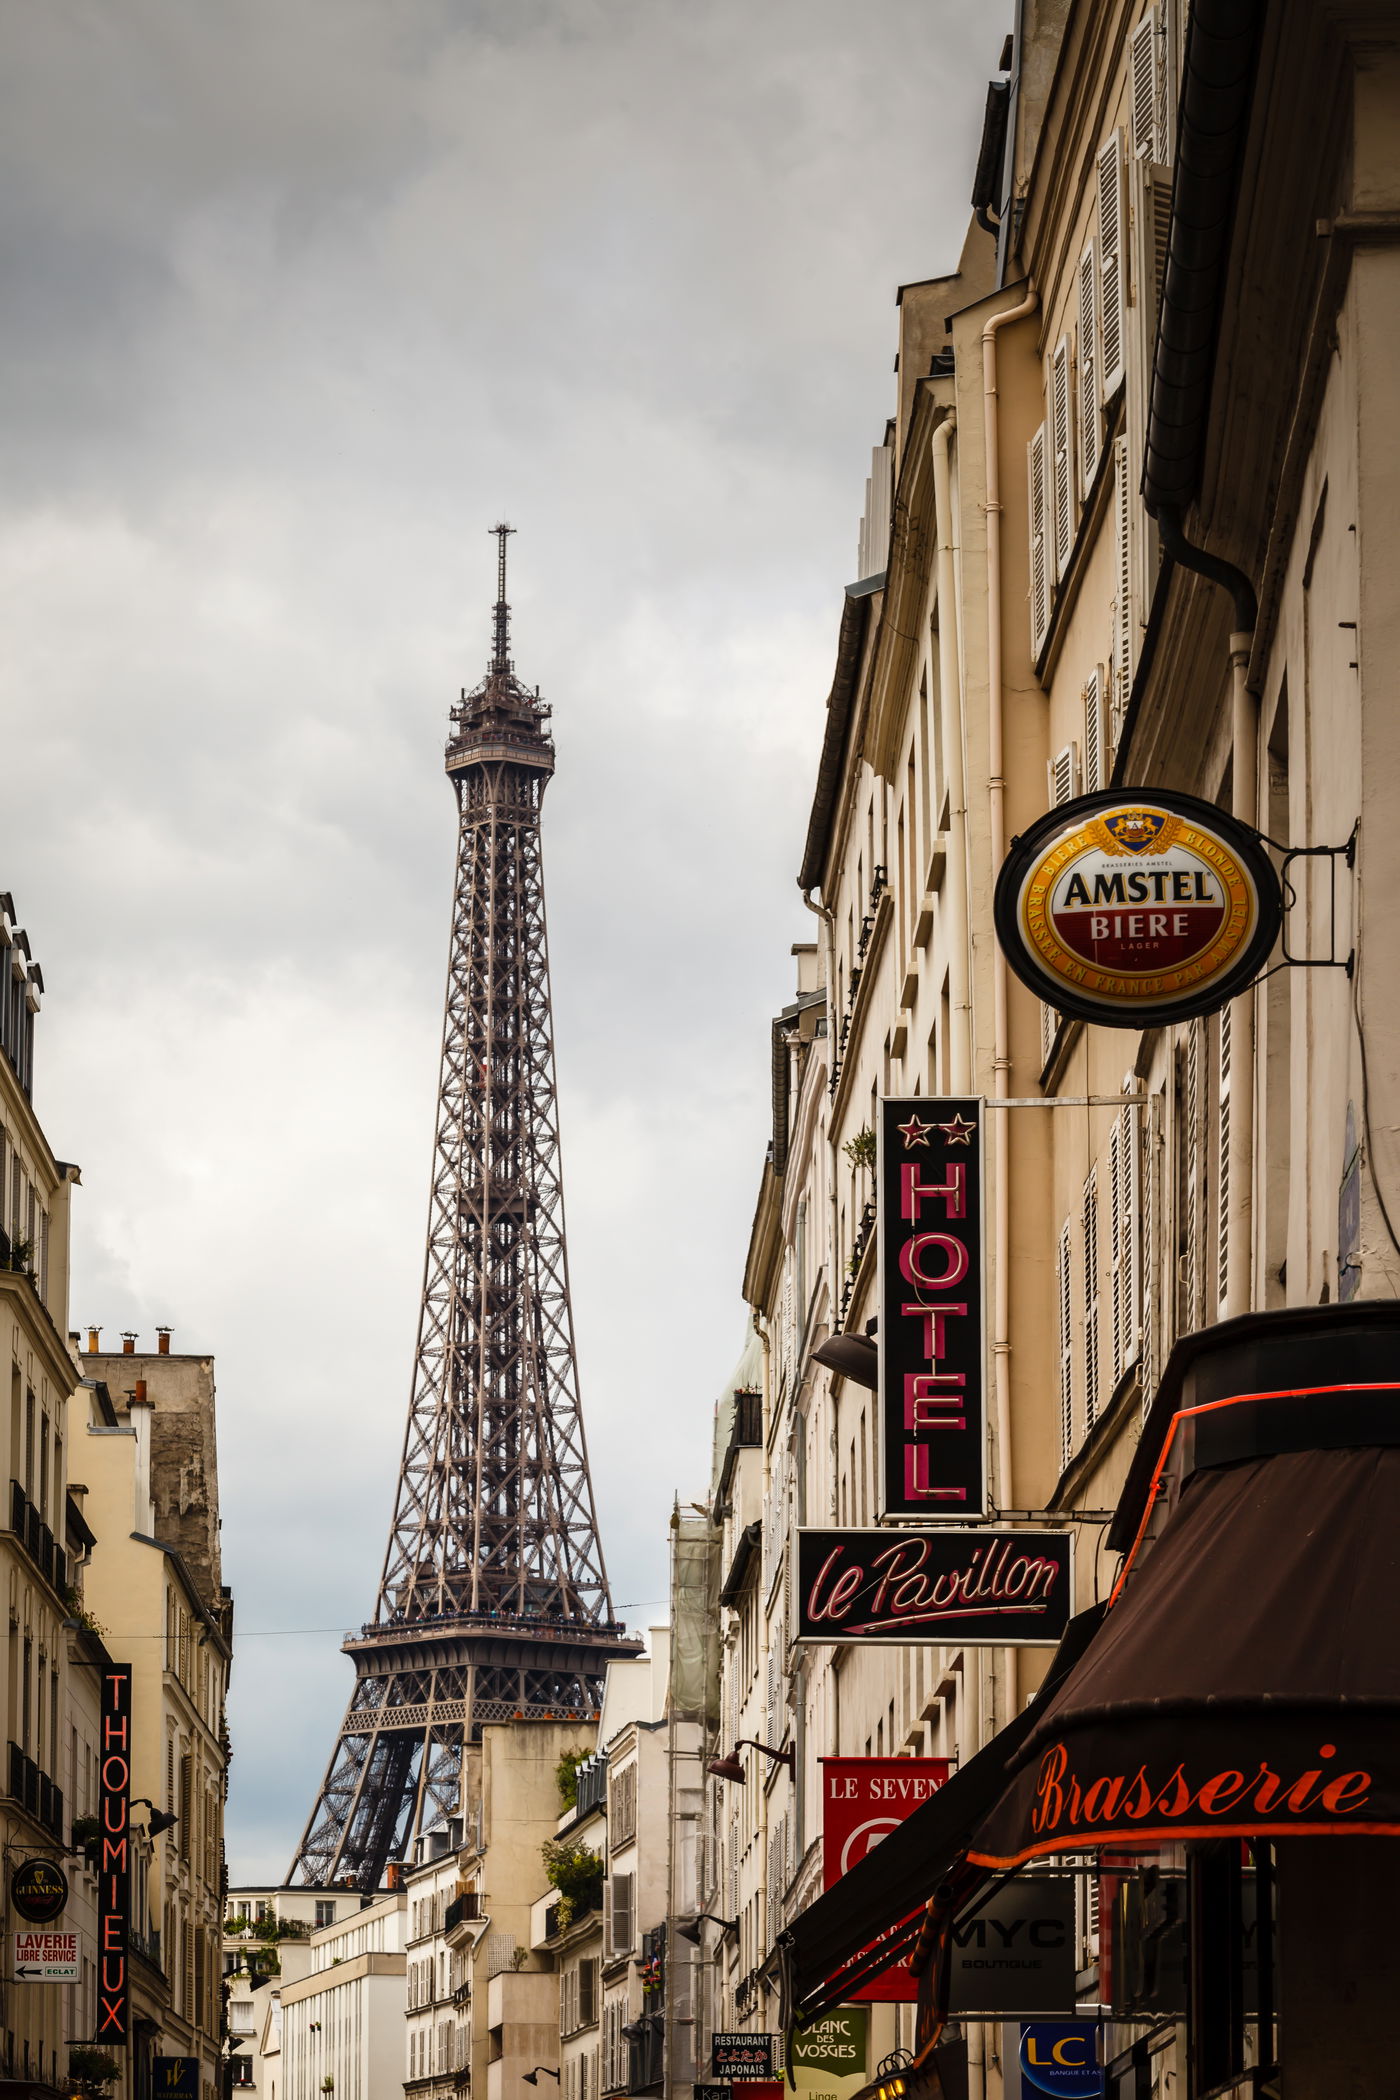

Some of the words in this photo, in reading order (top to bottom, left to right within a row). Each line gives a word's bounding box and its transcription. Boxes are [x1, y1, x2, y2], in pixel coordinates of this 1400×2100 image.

[1042, 834, 1089, 876] BIERE
[1186, 832, 1243, 888] BLONDE
[1063, 871, 1214, 907] AMSTEL
[1090, 914, 1189, 940] BIERE
[1028, 884, 1061, 964] BRASSEE
[1064, 962, 1088, 982] EN
[1095, 976, 1165, 995] FRANCE
[1174, 963, 1205, 986] PAR
[1211, 899, 1247, 967] AMSTEL
[1120, 942, 1160, 950] LAGER
[899, 1162, 969, 1500] HOTEL
[870, 1537, 1060, 1614] Pavillon
[830, 1778, 859, 1799] LE
[1032, 1742, 1372, 1833] Brasserie
[100, 1674, 129, 2033] THOUMIEUX
[16, 1885, 64, 1895] GUINNESS
[16, 1935, 76, 1949] LAVERIE
[16, 1950, 40, 1961] LIBRE
[42, 1950, 76, 1962] SERVICE
[961, 1959, 1042, 1968] BOUTIQUE
[714, 2036, 769, 2046] RESTAURANT
[816, 2035, 834, 2043] DES
[716, 2048, 768, 2063] とよたか
[795, 2044, 856, 2058] VOSGES
[719, 2064, 765, 2075] JAPONAIS
[808, 2091, 838, 2100] Linge
